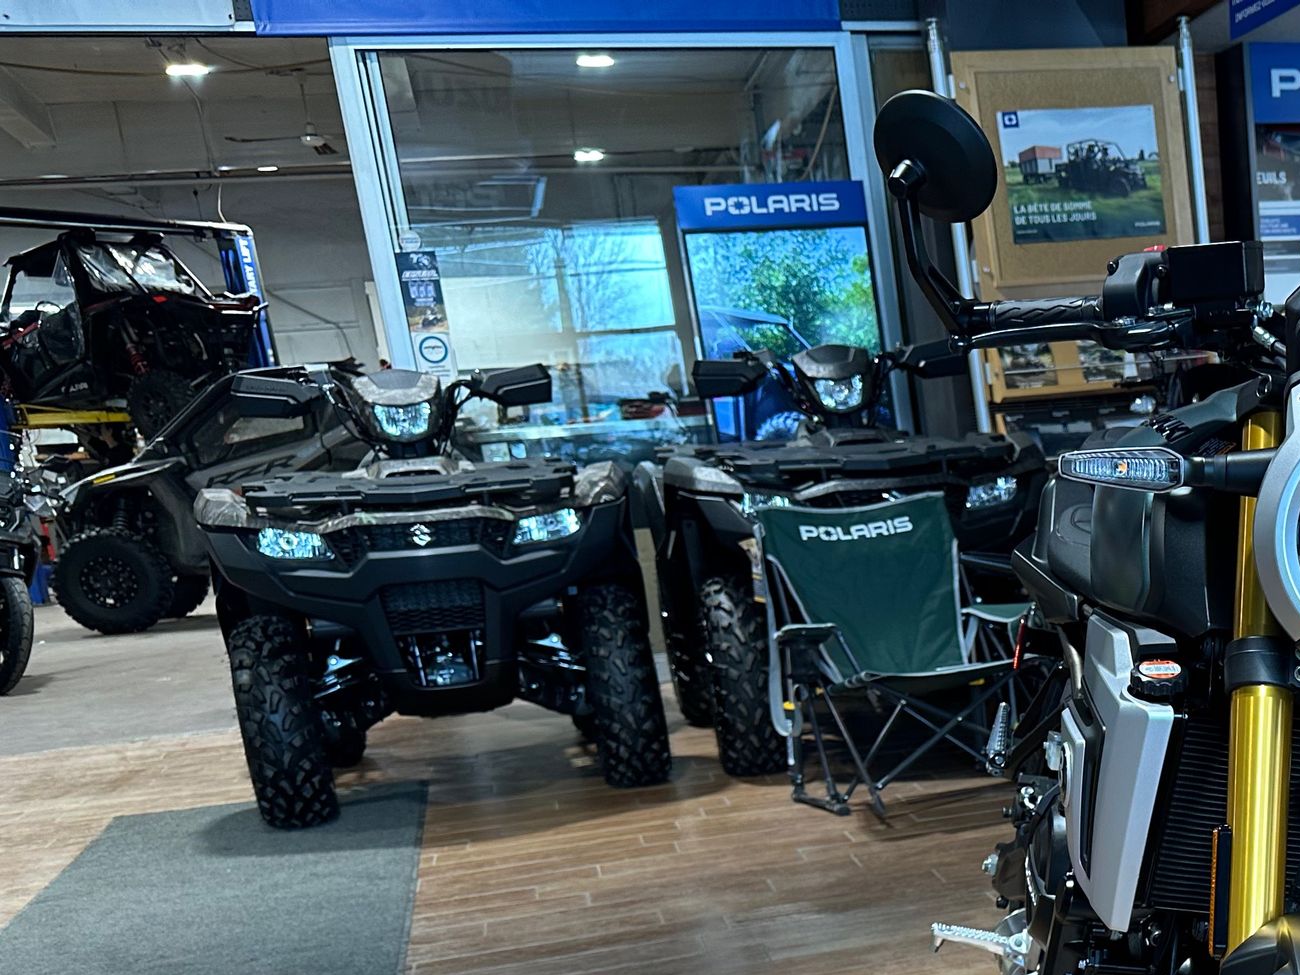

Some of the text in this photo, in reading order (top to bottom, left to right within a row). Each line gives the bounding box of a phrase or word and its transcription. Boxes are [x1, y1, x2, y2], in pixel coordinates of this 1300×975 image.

[704, 193, 840, 216] POLARIS
[1014, 205, 1027, 214] LA
[1028, 203, 1049, 213] BÊTE
[1050, 203, 1062, 212] DE
[1015, 212, 1097, 225] DE TOUS LES JOURS
[238, 238, 252, 263] LIFT
[206, 454, 297, 488] RZR
[799, 516, 913, 541] POLARIS
